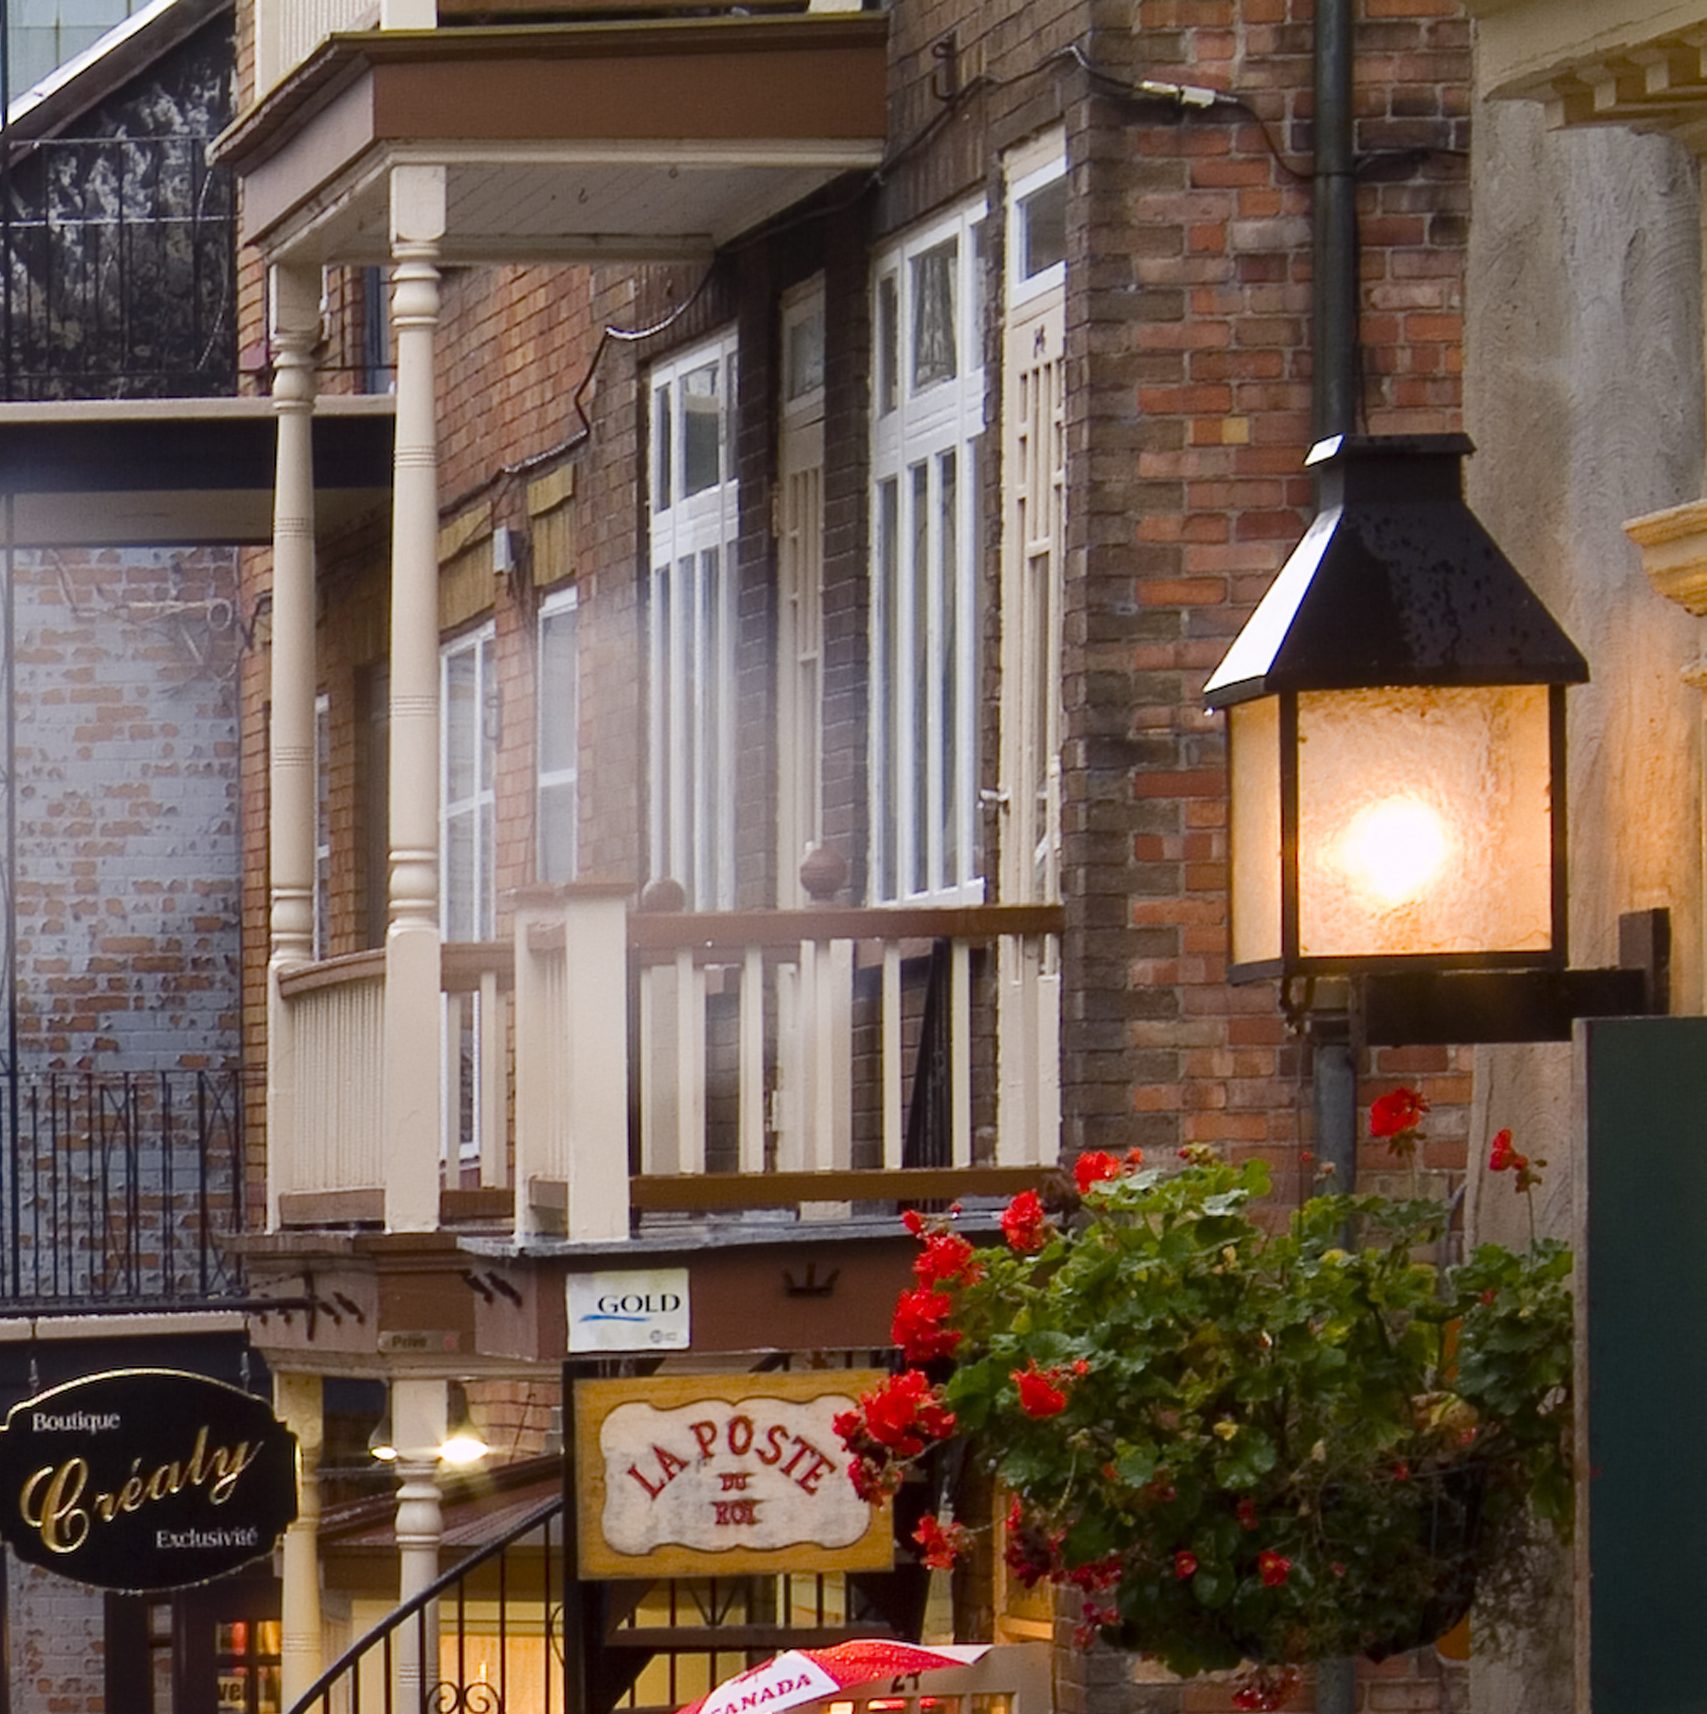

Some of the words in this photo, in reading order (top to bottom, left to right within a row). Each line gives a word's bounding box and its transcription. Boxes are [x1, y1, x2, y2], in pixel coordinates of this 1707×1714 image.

[597, 1292, 680, 1314] GOLD
[31, 1411, 122, 1436] Boutique
[688, 1414, 838, 1496] POSTE
[19, 1424, 265, 1554] Créaly
[719, 1472, 750, 1491] DU
[155, 1526, 260, 1549] Exclusivité
